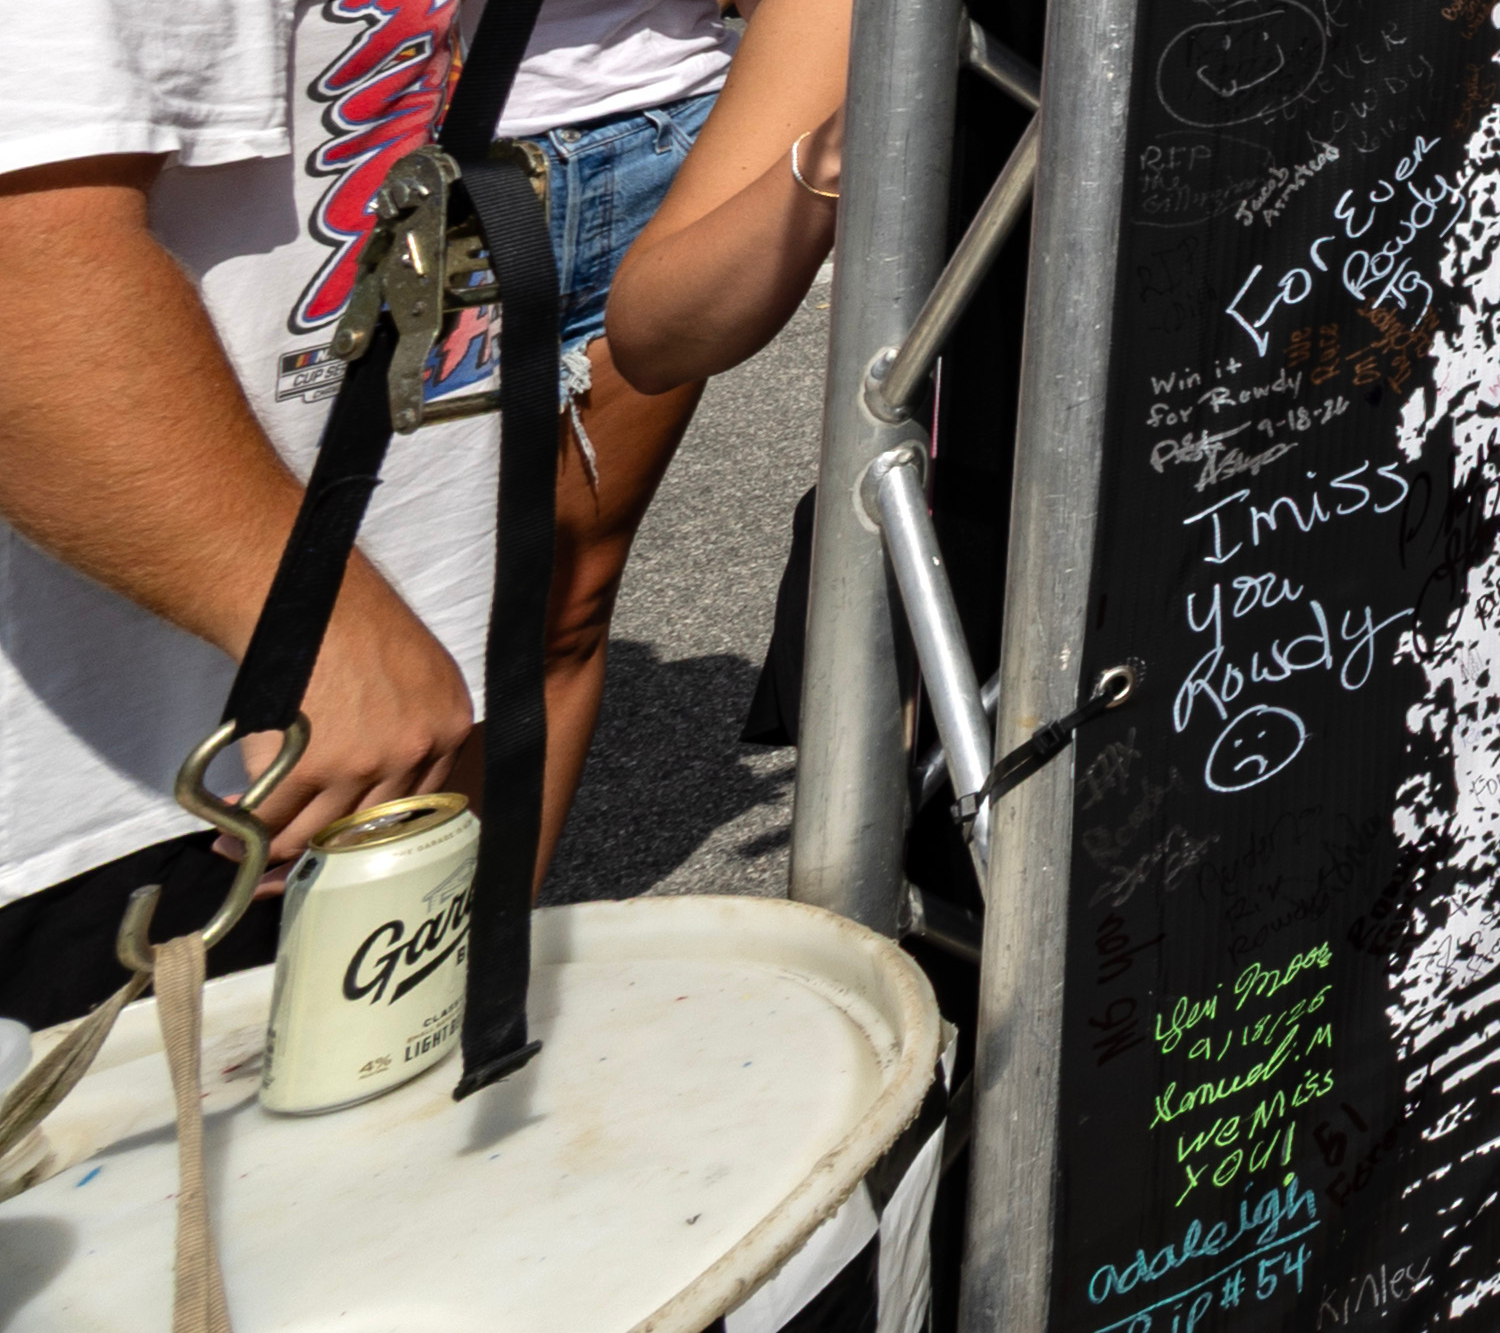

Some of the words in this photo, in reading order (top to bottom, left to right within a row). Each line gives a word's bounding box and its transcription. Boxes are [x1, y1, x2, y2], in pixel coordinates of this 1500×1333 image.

[293, 369, 324, 386] CUP
[1151, 368, 1201, 395] Win
[1214, 358, 1244, 381] it
[1198, 370, 1304, 414] Rowdy
[1174, 600, 1414, 733] Rowdy
[405, 1026, 449, 1063] LIGHT
[359, 1053, 392, 1074] 4%
